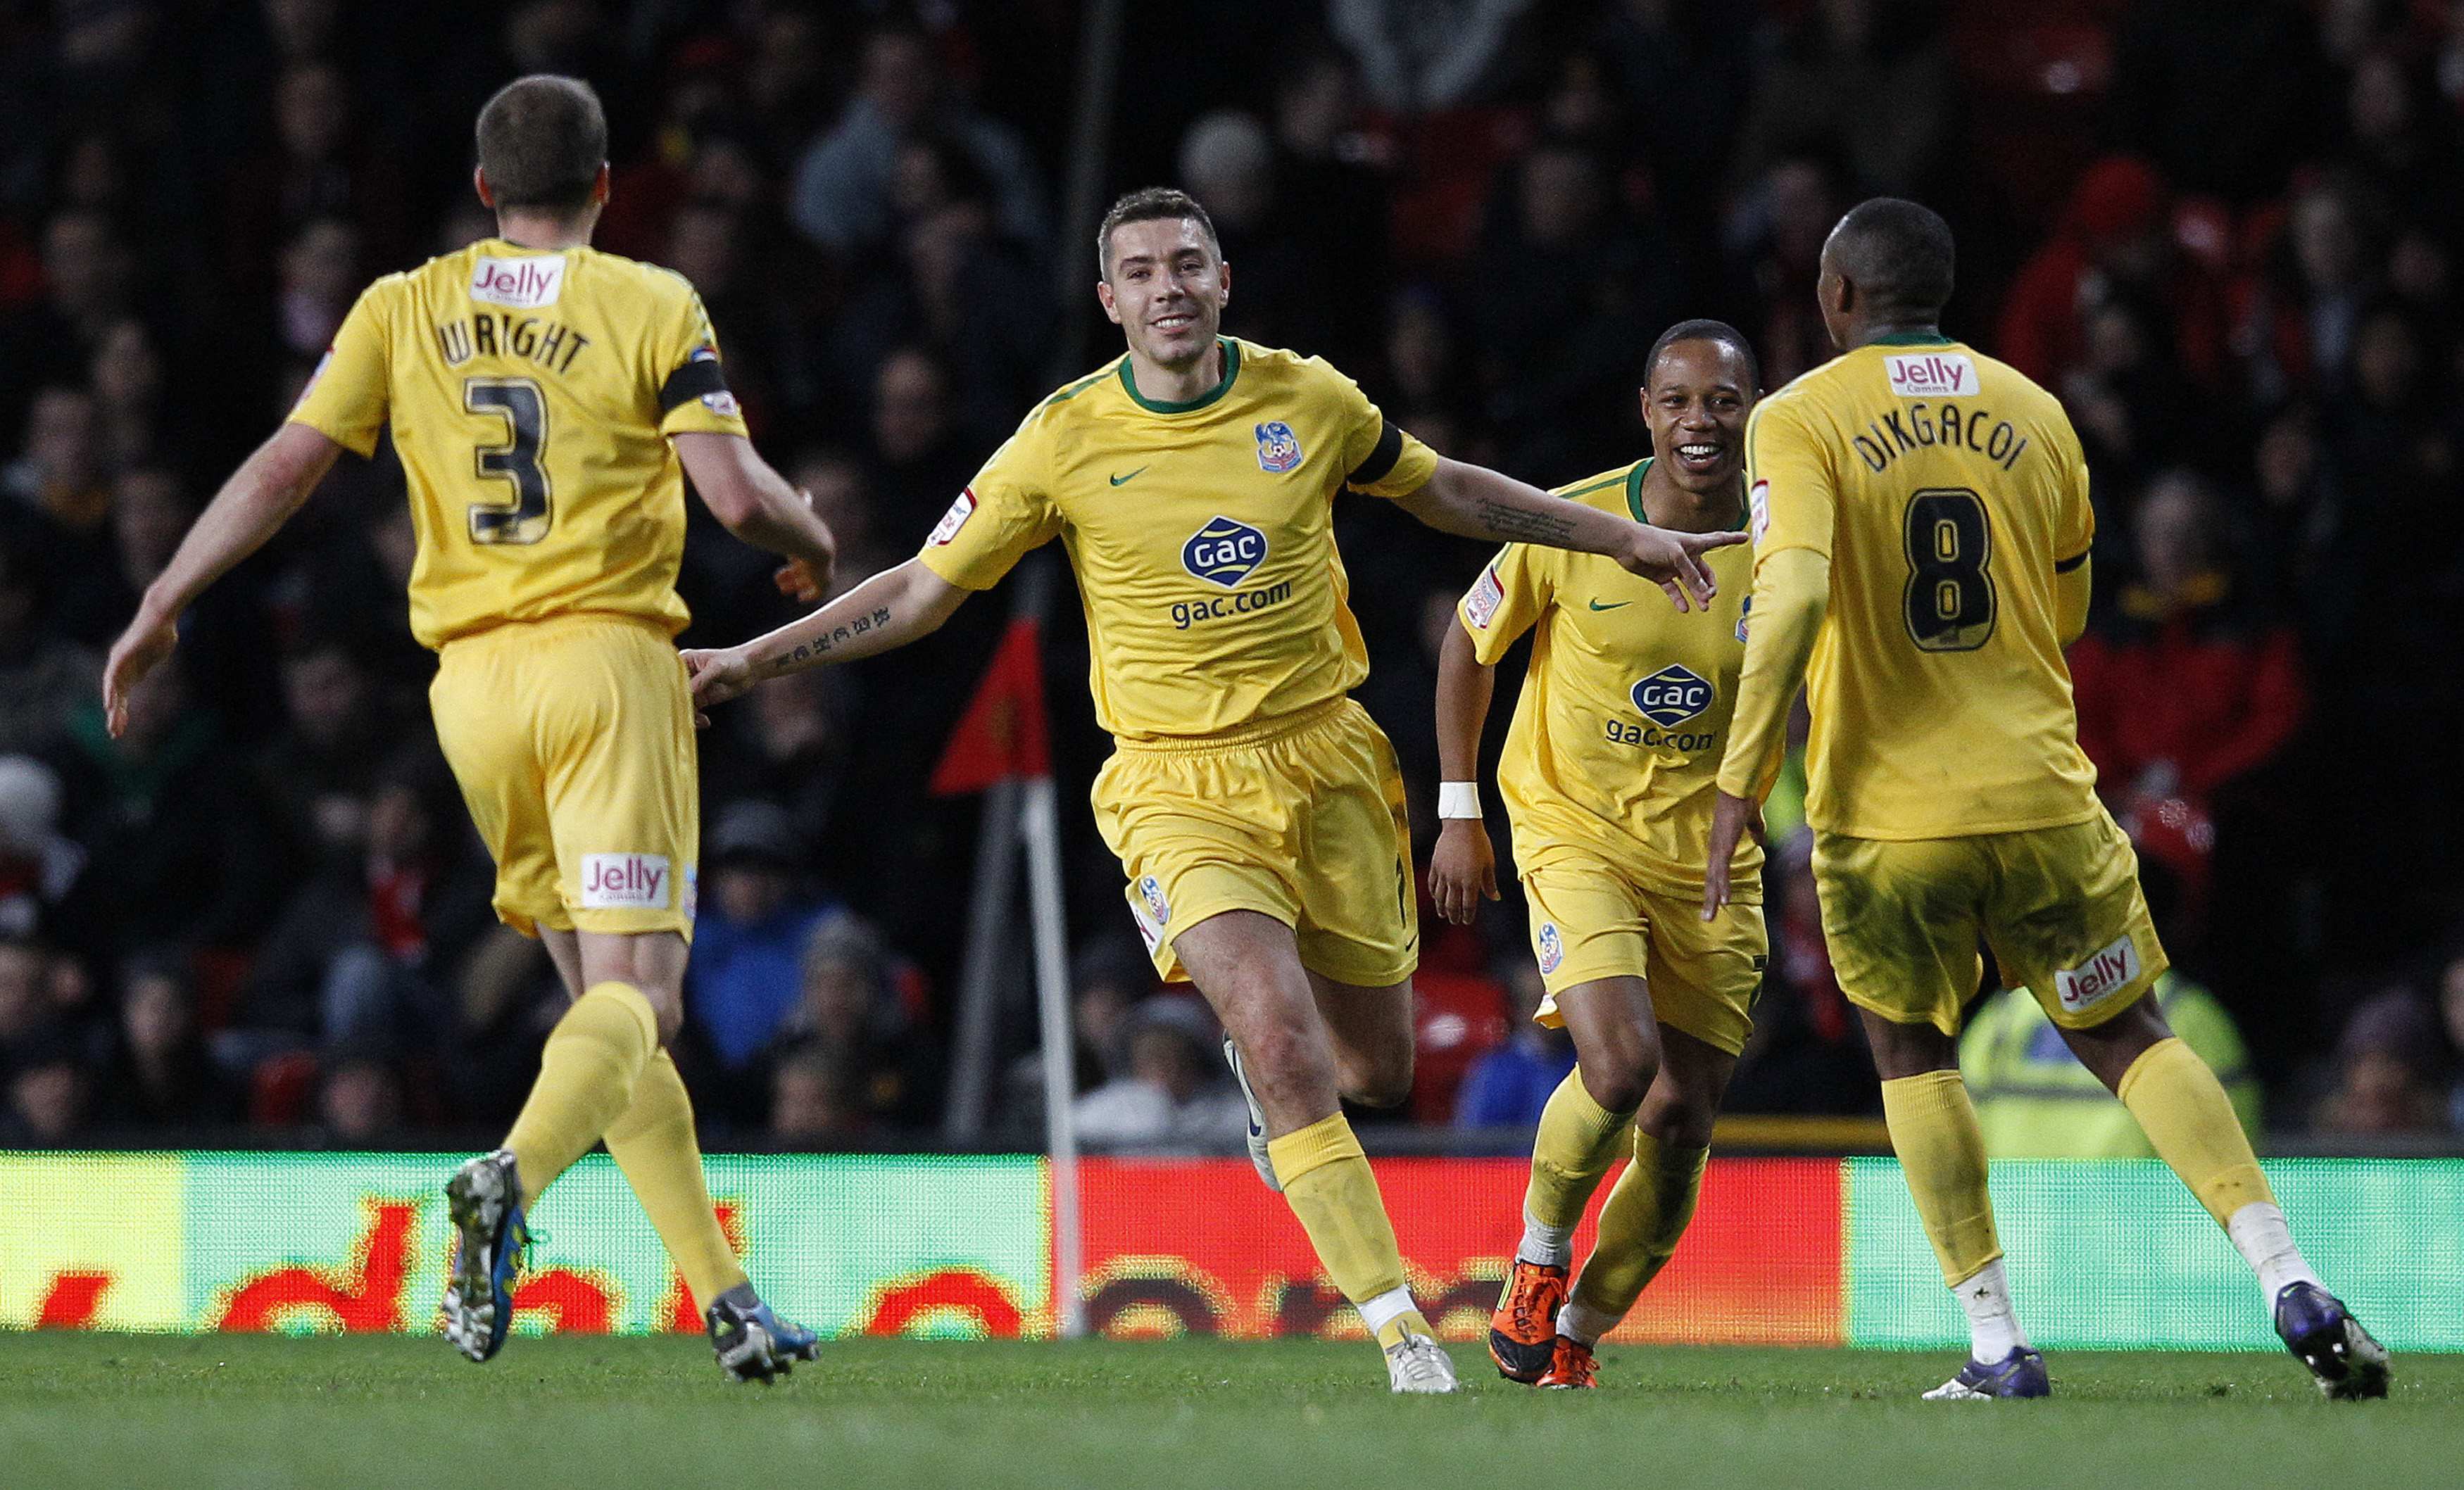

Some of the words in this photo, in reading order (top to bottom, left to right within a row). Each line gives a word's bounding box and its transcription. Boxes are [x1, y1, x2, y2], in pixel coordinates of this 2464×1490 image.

[474, 263, 555, 303] Jelly
[439, 314, 590, 374] WRIGHT
[1892, 357, 1963, 392] Jelly
[1906, 384, 1949, 393] Comms
[464, 376, 554, 545] 3
[1852, 401, 2028, 474] DIKGACOI
[1902, 487, 1998, 653] 8
[1171, 581, 1292, 631] gac.com
[1605, 719, 1718, 752] gac.com
[588, 857, 665, 901] Jelly
[2064, 949, 2127, 1002] Jelly
